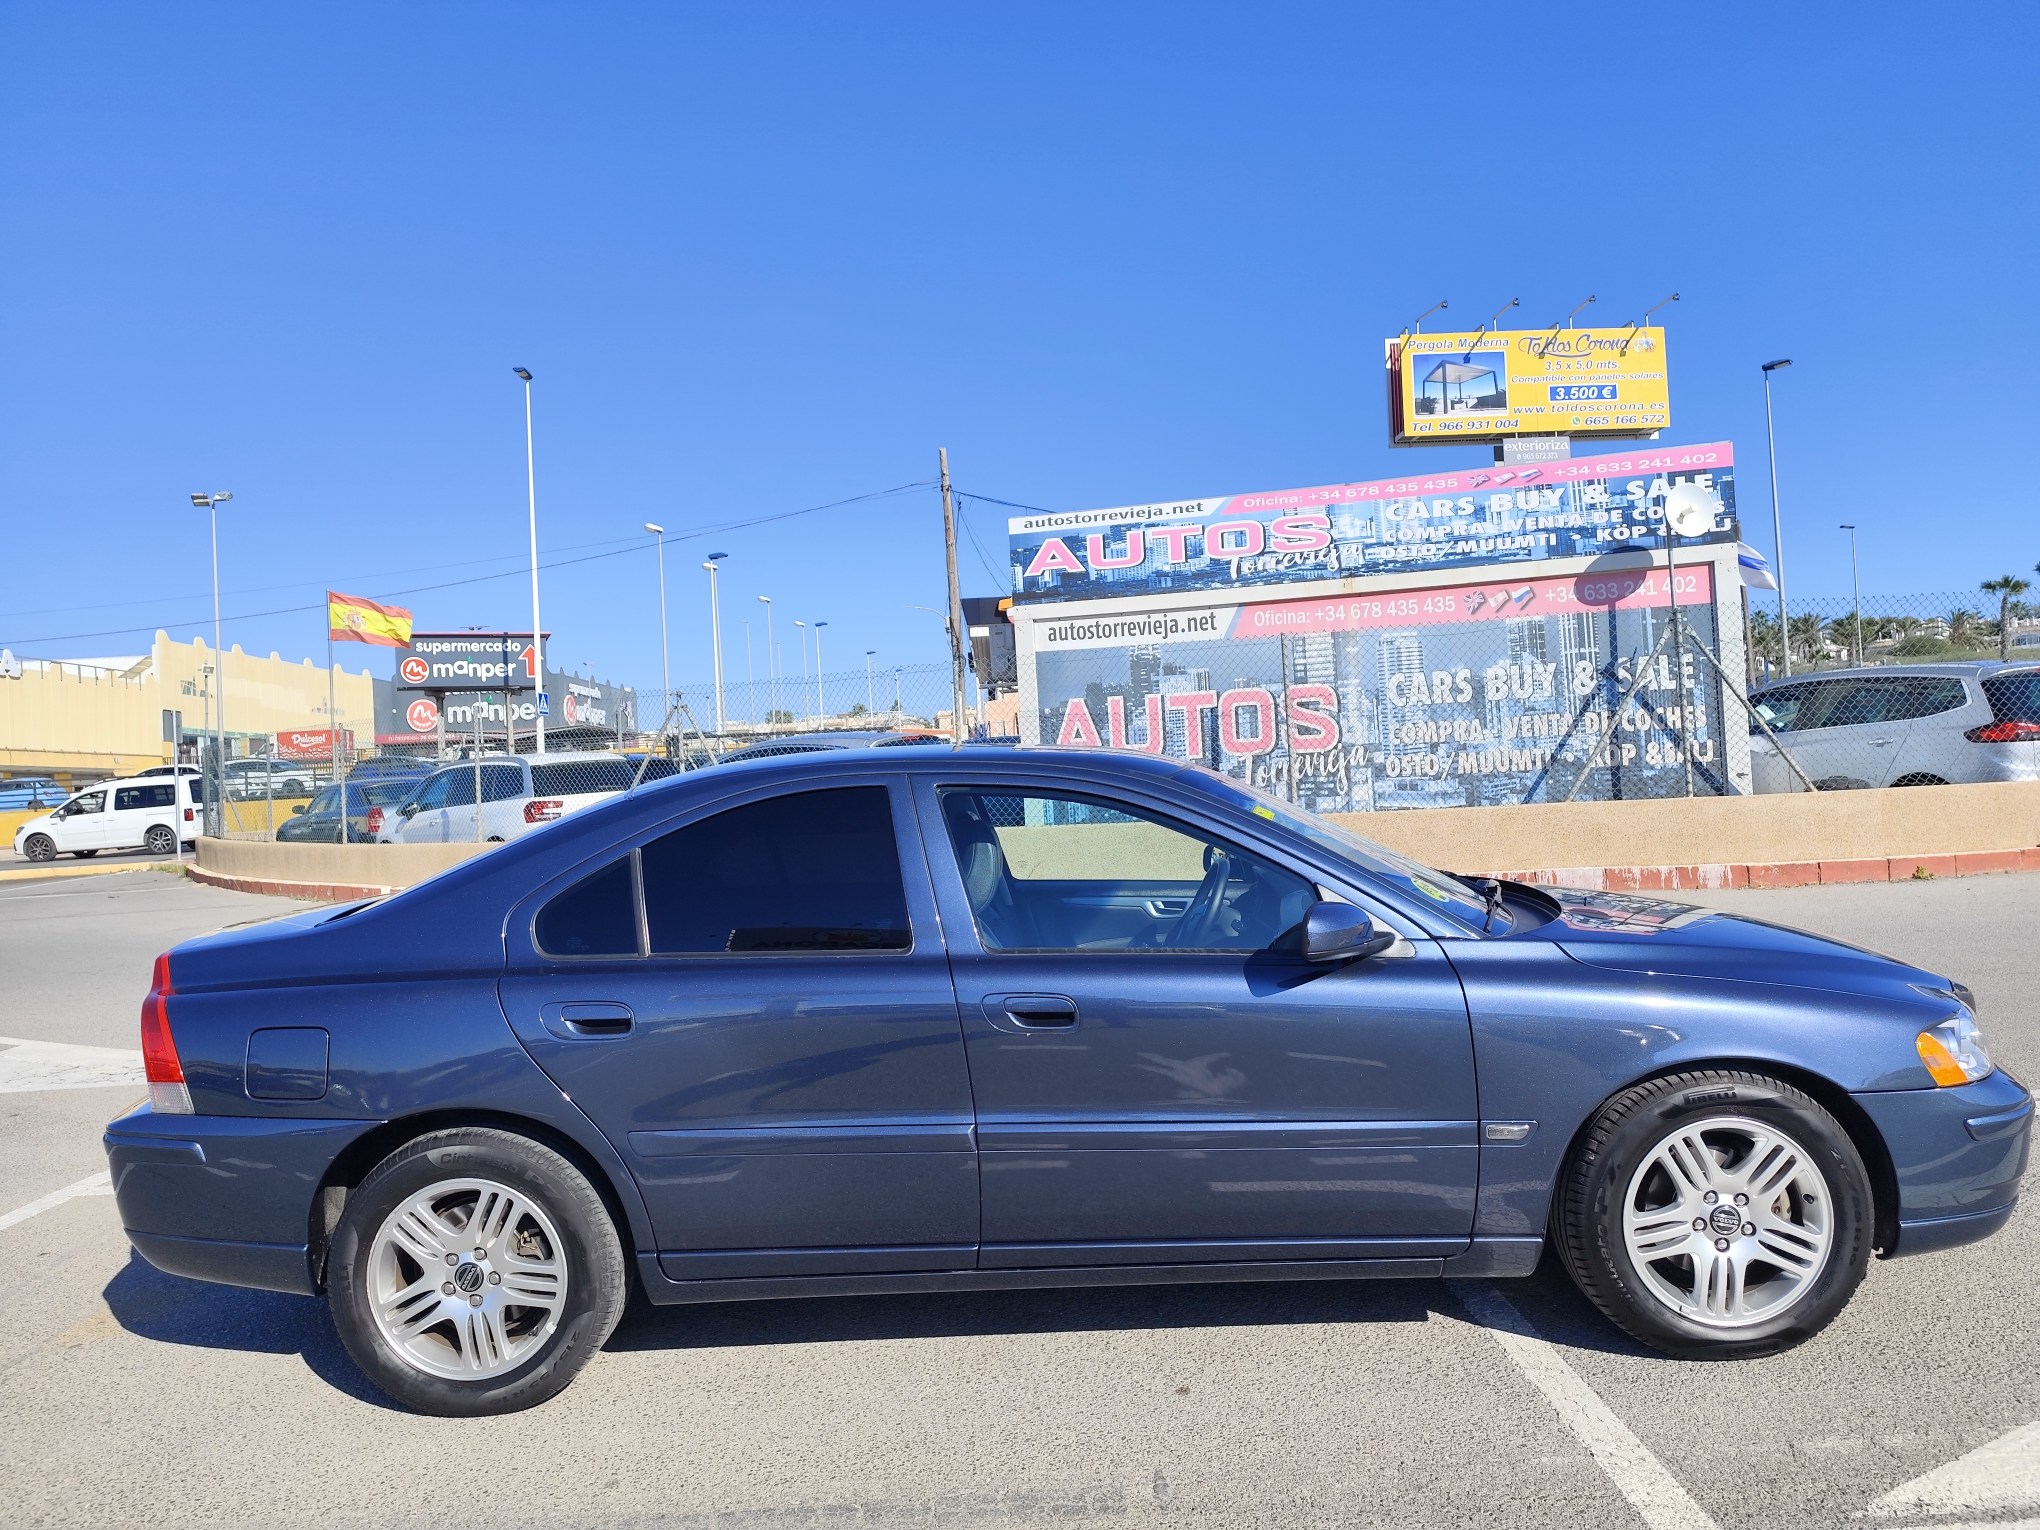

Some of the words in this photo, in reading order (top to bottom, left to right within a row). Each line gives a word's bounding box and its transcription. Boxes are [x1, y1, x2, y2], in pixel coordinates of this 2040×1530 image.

[1458, 338, 1509, 348] Moderna
[1545, 361, 1562, 371] 3,5
[1576, 360, 1593, 370] 5,0
[1596, 361, 1620, 369] mts.
[1511, 374, 1566, 383] Compatible
[1590, 373, 1626, 383] paneles
[1555, 386, 1598, 399] 3.500
[1602, 386, 1612, 398] €
[1513, 402, 1665, 414] www.toldoscorona.es
[1412, 422, 1434, 432] Tel.
[1438, 421, 1463, 431] 966
[1467, 420, 1490, 430] 931
[1495, 419, 1519, 429] 004
[1585, 416, 1609, 425] 665
[1614, 415, 1637, 424] 166
[1641, 414, 1664, 424] 572
[1503, 440, 1569, 452] exterioriza
[1554, 464, 1590, 477] +34
[1595, 461, 1632, 473] 633
[1638, 457, 1675, 469] 241
[1680, 452, 1717, 465] 402
[1243, 494, 1302, 509] Oficina:
[1308, 489, 1340, 501] +34
[1345, 486, 1379, 497] 678
[1385, 482, 1418, 494] 435
[1423, 478, 1458, 490] 435
[1385, 496, 1475, 521] CARS
[1490, 487, 1566, 513] BUY
[1583, 485, 1610, 504] &
[1024, 501, 1204, 529] autostorrevieja.net
[1592, 509, 1624, 524] DE
[1596, 524, 1648, 542] KÖP
[1023, 514, 1333, 577] AUTOS
[1545, 586, 1579, 603] +34
[1584, 583, 1619, 600] 633
[1624, 580, 1657, 597] 241
[1662, 576, 1697, 593] 402
[1254, 609, 1310, 627] Oficina:
[1315, 605, 1346, 621] +34
[1351, 602, 1382, 619] 678
[1387, 599, 1419, 616] 435
[1423, 595, 1456, 613] 435
[1048, 612, 1217, 641] autostorrevieja.net
[415, 640, 521, 655] supermercado
[432, 660, 517, 682] manper
[1387, 668, 1473, 707] CARS
[1486, 662, 1557, 701] BUY
[1573, 660, 1600, 695] &
[1617, 653, 1695, 693] SALE
[447, 701, 537, 727] manpe
[1057, 683, 1340, 760] AUTOS
[1682, 1087, 1736, 1105] PIRELLI
